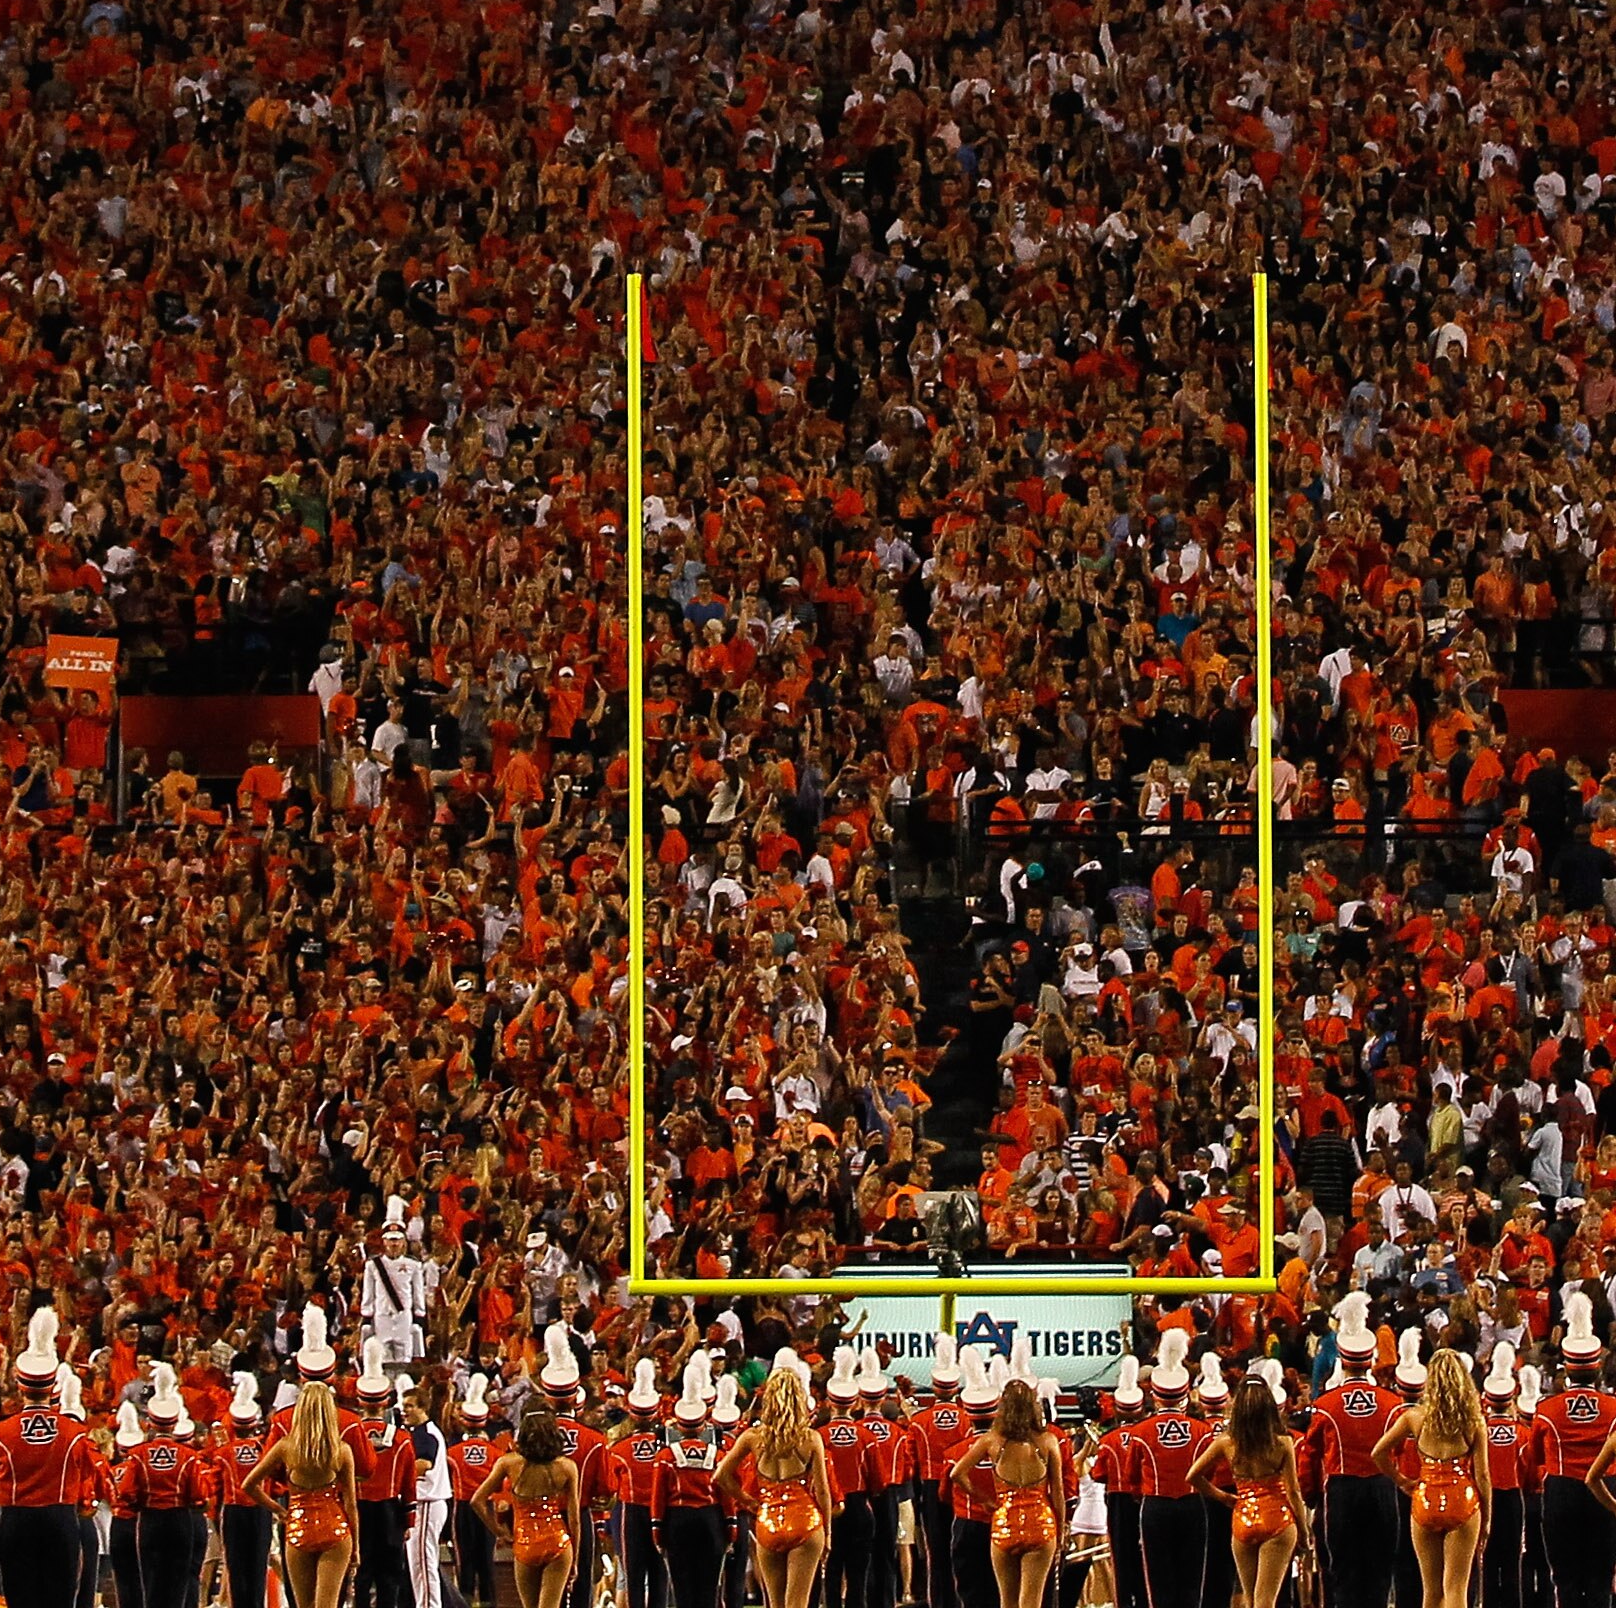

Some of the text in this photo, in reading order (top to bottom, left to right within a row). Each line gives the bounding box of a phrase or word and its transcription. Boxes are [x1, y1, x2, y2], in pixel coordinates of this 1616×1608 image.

[46, 657, 114, 672] ALL IN
[1028, 1331, 1122, 1357] TIGERS
